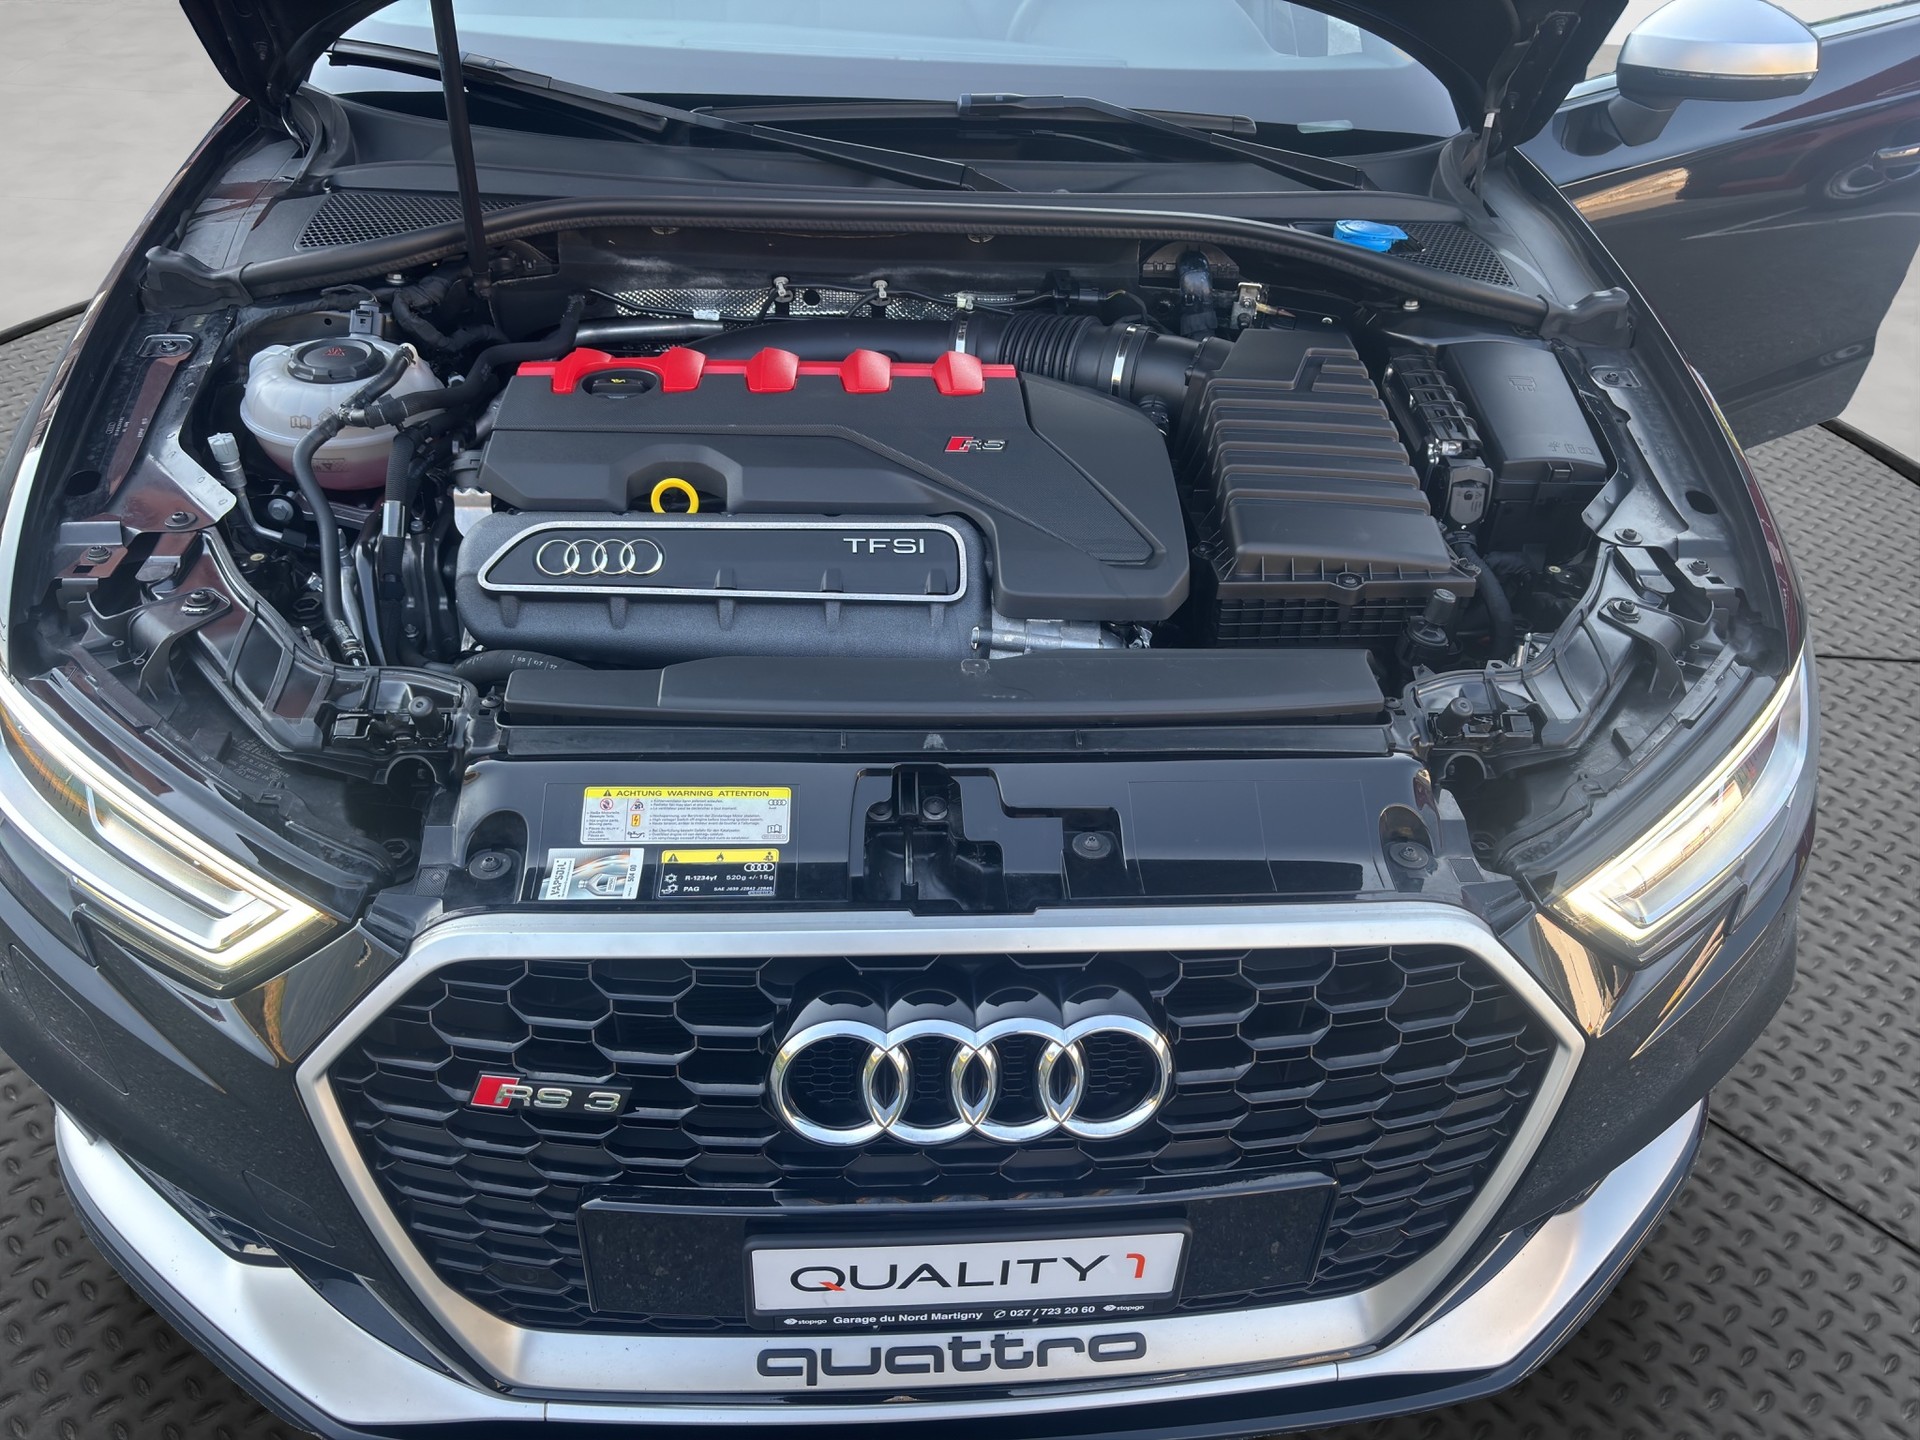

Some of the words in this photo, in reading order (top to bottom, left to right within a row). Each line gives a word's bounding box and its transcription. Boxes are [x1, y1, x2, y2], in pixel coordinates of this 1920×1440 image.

[957, 438, 1006, 451] RS
[843, 538, 925, 554] TFSI
[493, 1083, 573, 1109] RS
[583, 1091, 621, 1113] 3
[790, 1254, 1110, 1292] QUALITY
[1126, 1253, 1146, 1279] 1
[833, 1316, 877, 1325] Garage
[880, 1314, 896, 1322] du
[898, 1314, 928, 1322] Nord
[931, 1312, 983, 1321] Martigny
[1010, 1309, 1030, 1317] 027
[1041, 1307, 1061, 1316] 723
[1064, 1306, 1078, 1314] 20
[1081, 1305, 1096, 1314] 60
[756, 1331, 1148, 1387] quattro
